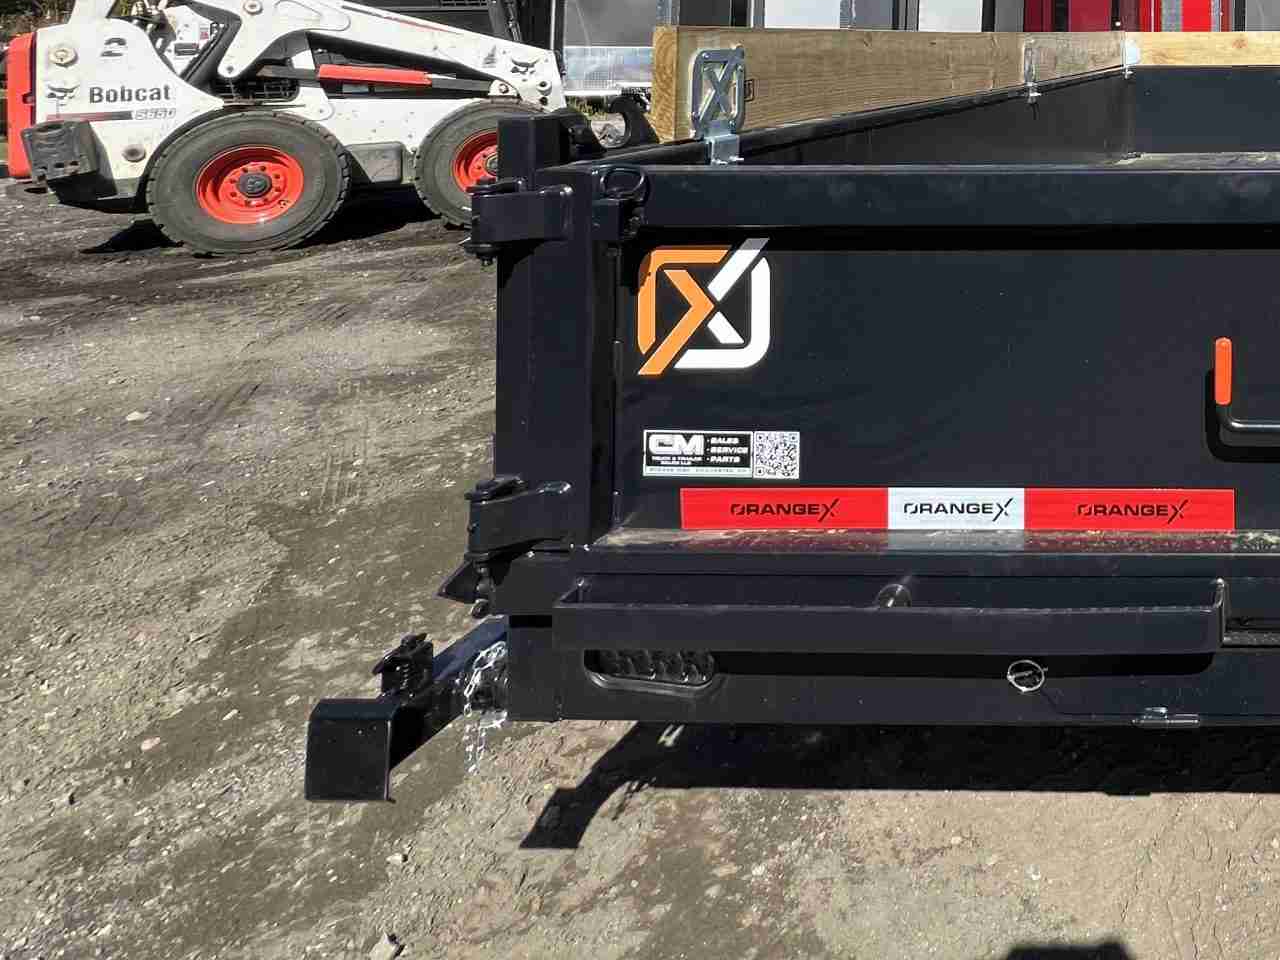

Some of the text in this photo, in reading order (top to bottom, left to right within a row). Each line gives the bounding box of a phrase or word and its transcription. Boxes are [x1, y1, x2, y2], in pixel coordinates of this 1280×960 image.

[89, 85, 171, 104] Bobcat
[648, 434, 705, 456] CM
[710, 437, 740, 445] SALES
[710, 447, 750, 455] SERVICE
[710, 456, 741, 464] PARTS
